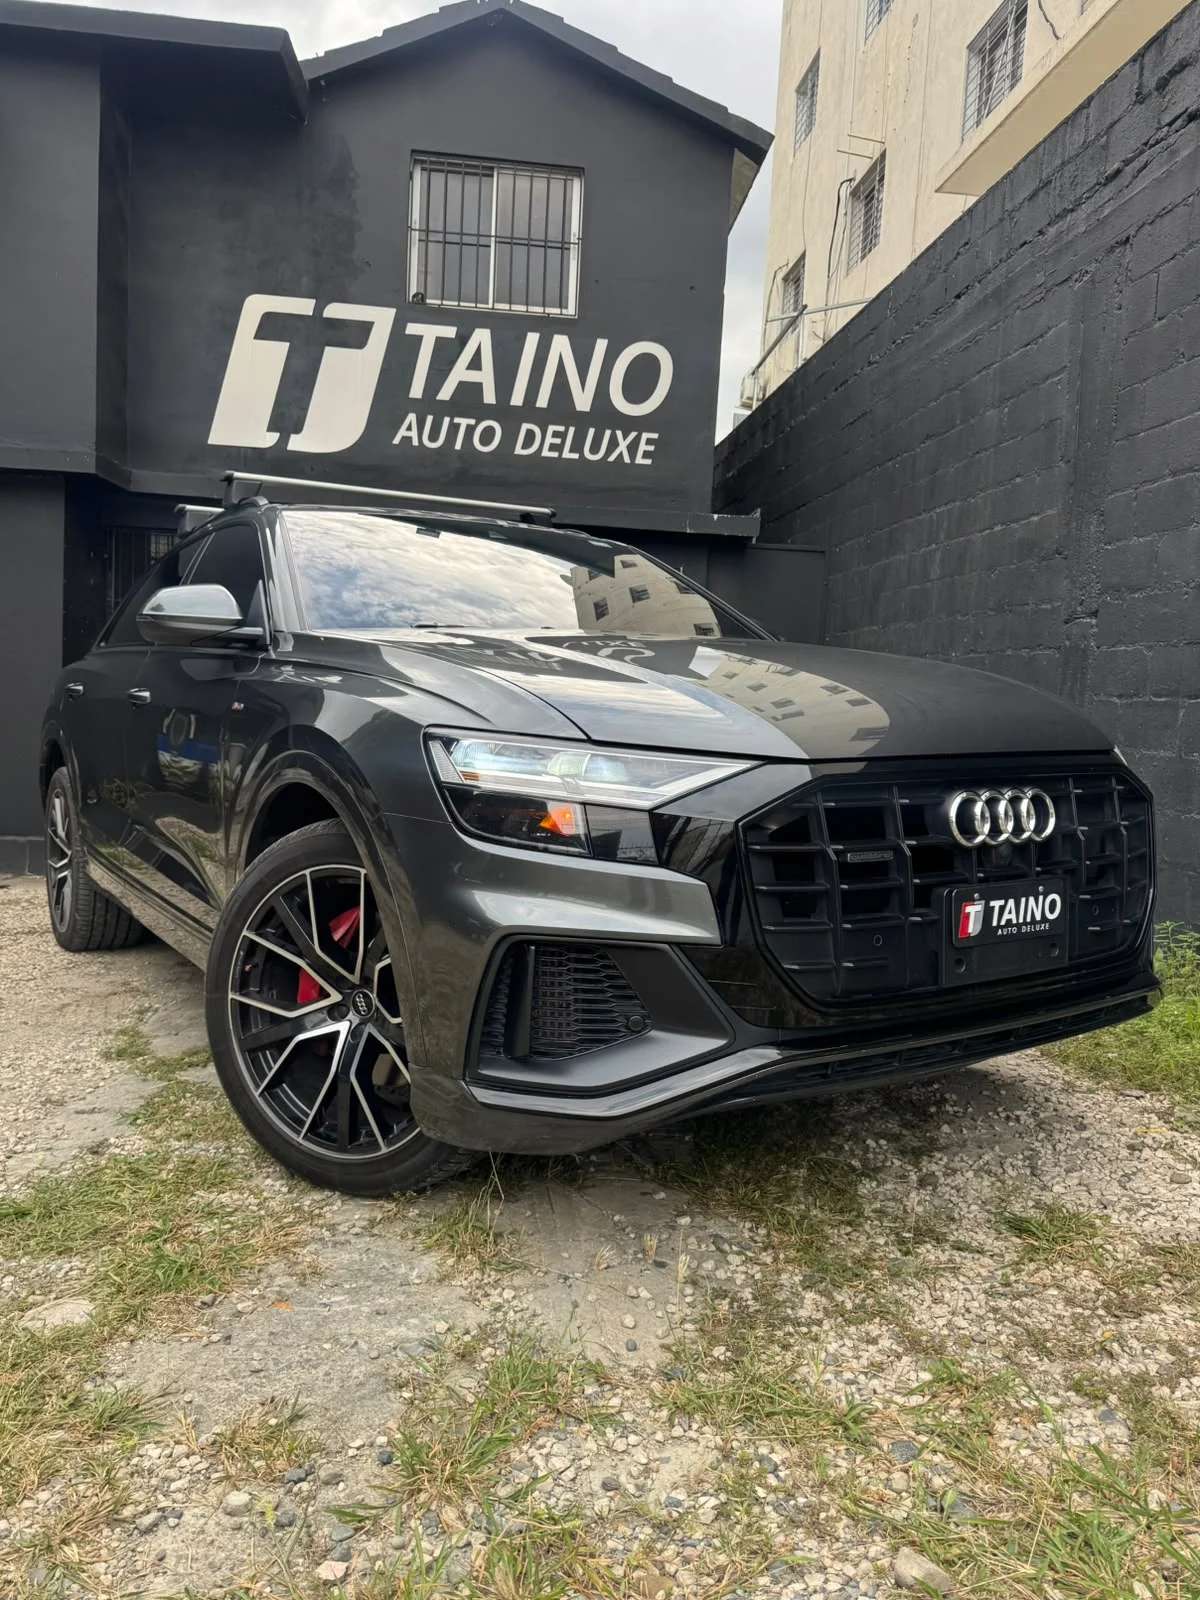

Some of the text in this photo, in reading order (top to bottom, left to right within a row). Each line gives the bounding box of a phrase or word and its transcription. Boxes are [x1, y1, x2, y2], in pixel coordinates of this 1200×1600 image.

[404, 322, 674, 417] TAINO
[391, 412, 659, 465] AUTO DELUXE
[989, 893, 1062, 927] TAINO
[997, 922, 1050, 936] AUTO DELUXE
